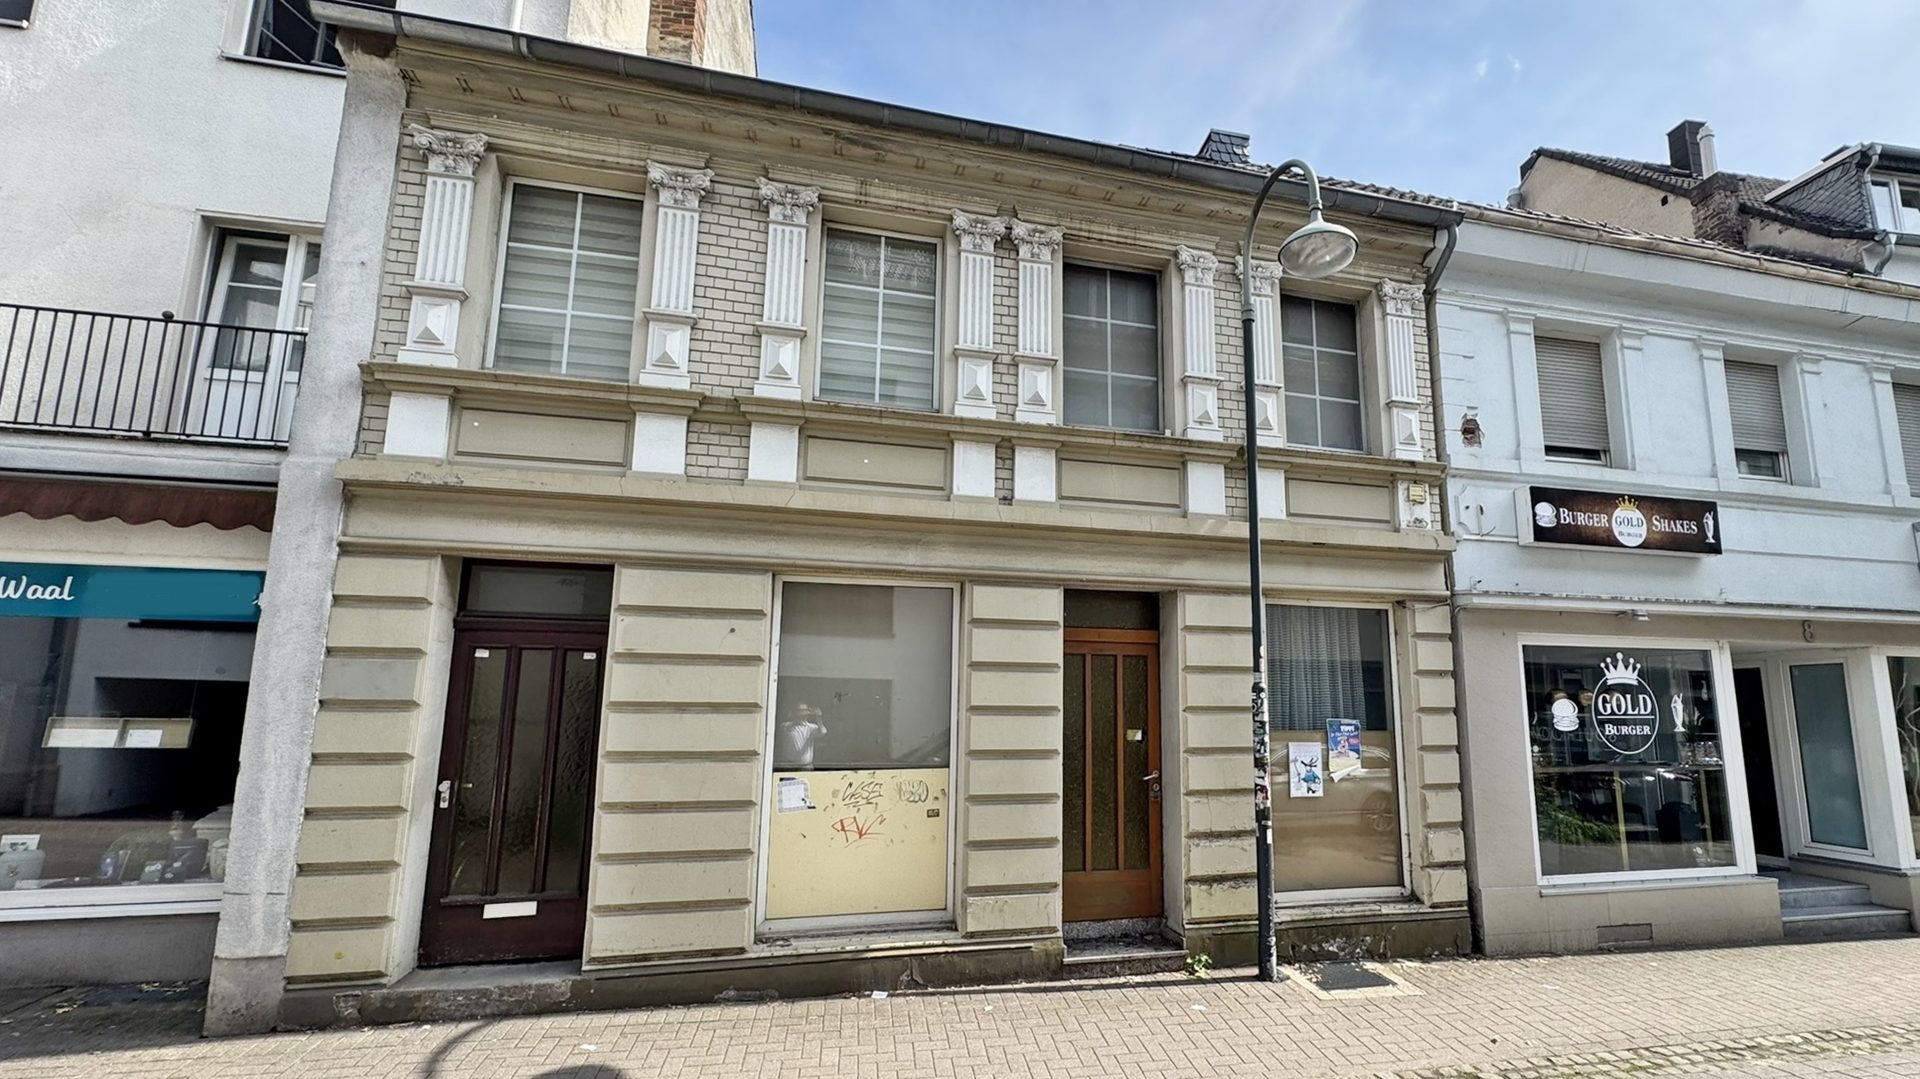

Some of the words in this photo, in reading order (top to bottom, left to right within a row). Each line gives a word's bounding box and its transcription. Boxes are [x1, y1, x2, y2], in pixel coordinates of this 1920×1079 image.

[1559, 507, 1609, 527] BURGER
[1651, 514, 1699, 534] SHAKES
[1614, 515, 1644, 528] GOLD
[0, 575, 75, 601] Waal
[1802, 619, 1815, 643] 8
[1597, 693, 1652, 716] GOLD
[1604, 723, 1652, 736] BURGER
